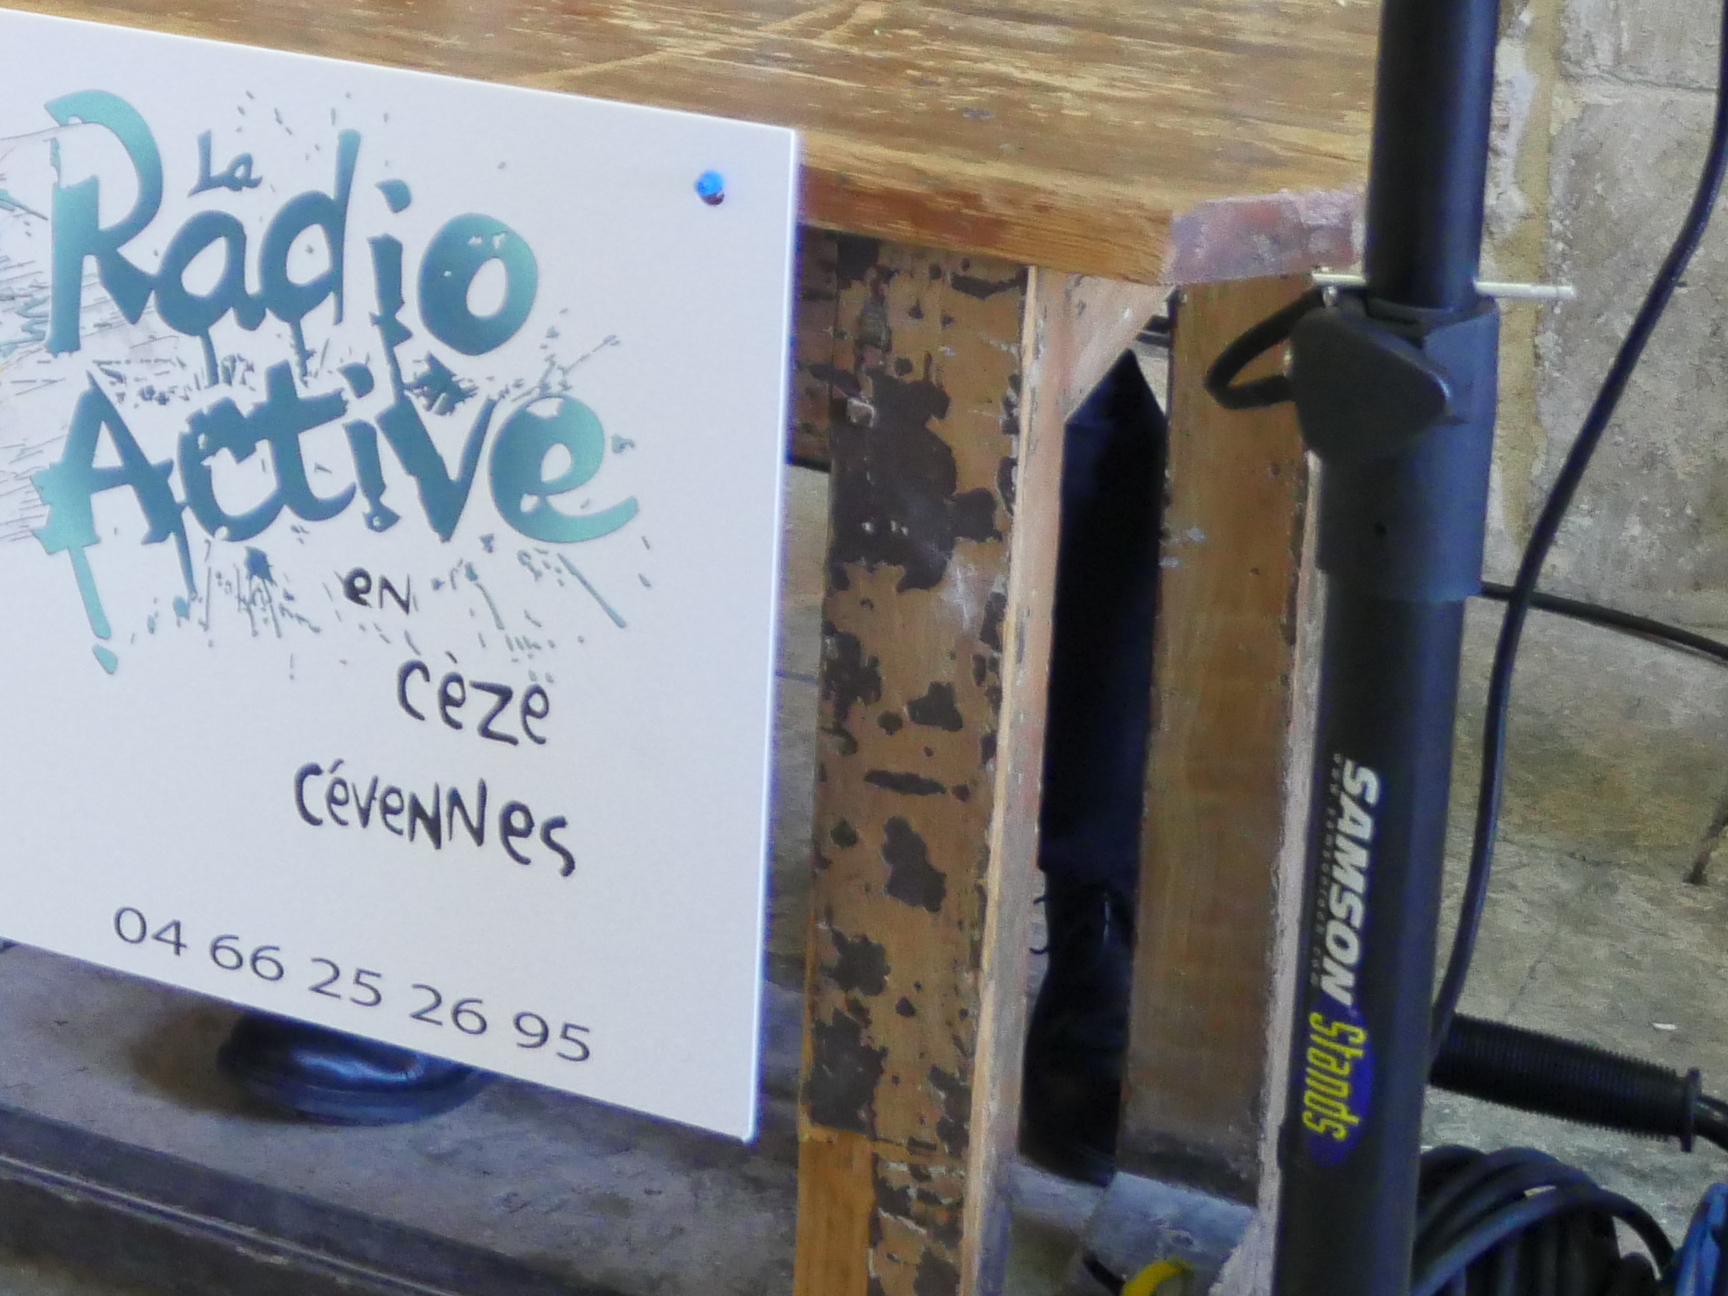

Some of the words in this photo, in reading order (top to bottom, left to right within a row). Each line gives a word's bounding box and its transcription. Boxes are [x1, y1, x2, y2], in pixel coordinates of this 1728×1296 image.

[44, 88, 540, 358] Radio
[188, 129, 263, 198] La
[31, 358, 640, 553] Active
[1319, 757, 1381, 1007] SAMSON
[112, 906, 188, 957] 04
[208, 933, 286, 982] 66
[308, 956, 384, 1008] 25
[409, 982, 489, 1036] 26
[511, 1010, 592, 1063] 95
[1301, 1011, 1368, 1142] Stands
